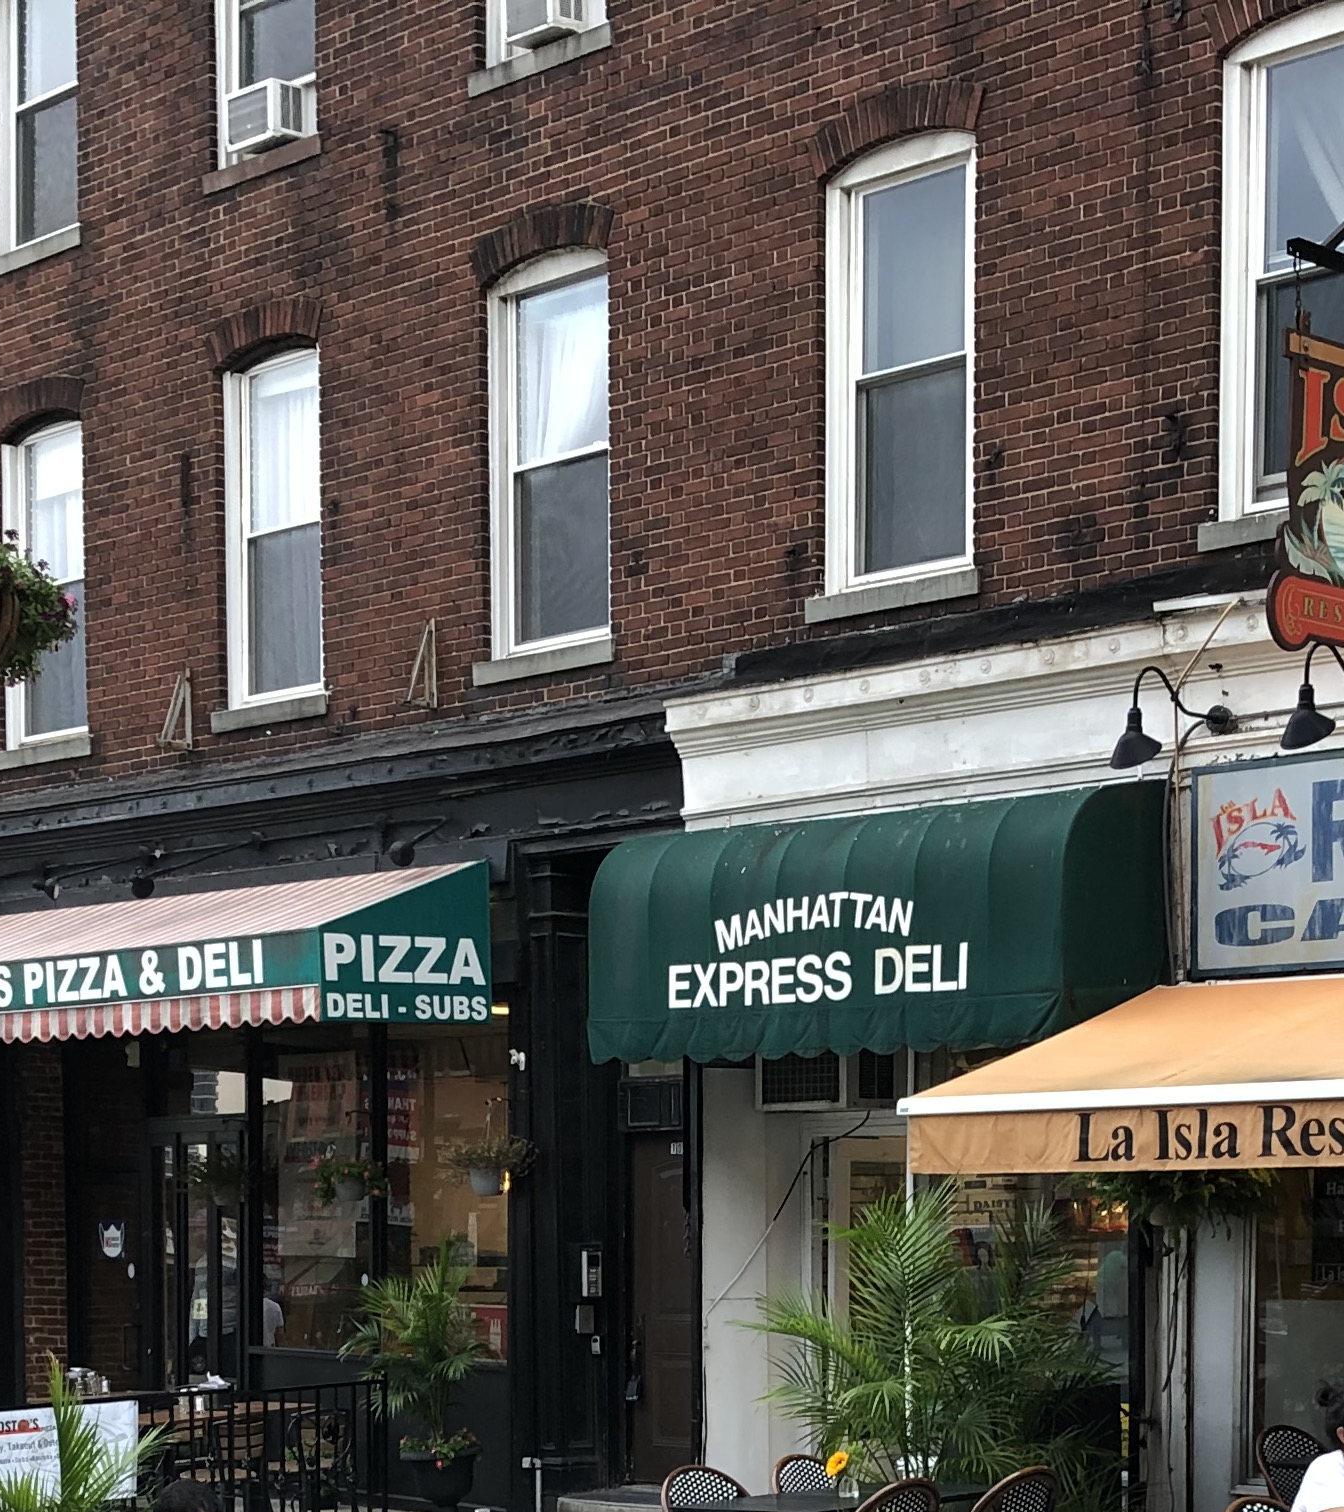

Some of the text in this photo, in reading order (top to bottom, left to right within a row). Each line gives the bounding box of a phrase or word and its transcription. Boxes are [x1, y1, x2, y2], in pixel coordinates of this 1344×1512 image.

[1209, 787, 1297, 859] ISLA
[714, 891, 914, 954] MANHATTAN
[23, 954, 128, 1006] PIZZA
[139, 950, 165, 995] &
[177, 938, 264, 992] DELI
[323, 932, 486, 986] PIZZA
[668, 942, 969, 1009] EXPRESS DELI
[326, 992, 390, 1019] DELI
[415, 994, 488, 1021] SUBS
[1072, 1112, 1136, 1163] La
[1154, 1108, 1240, 1161] Isla
[1321, 1265, 1335, 1281] La
